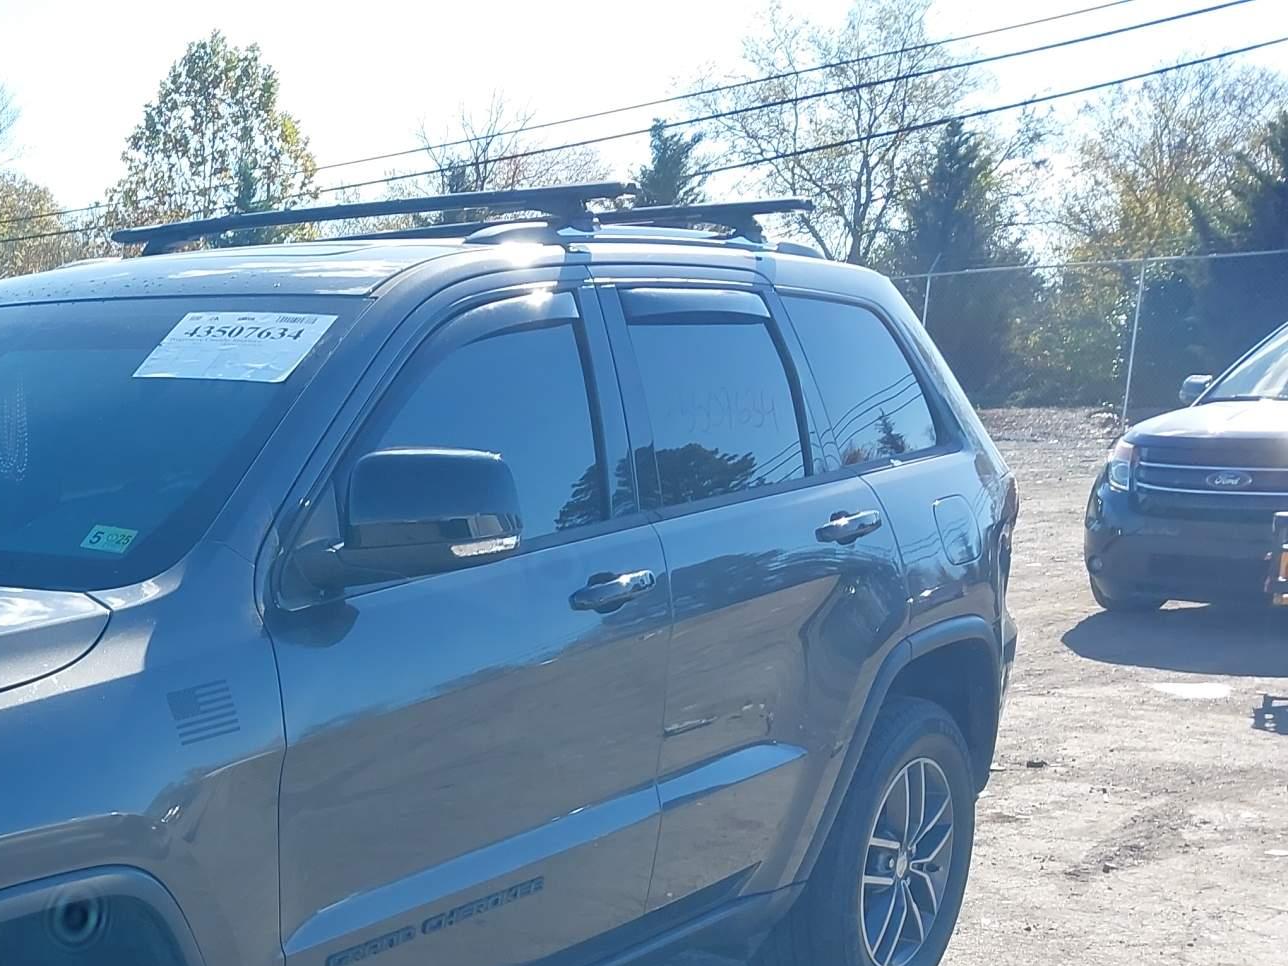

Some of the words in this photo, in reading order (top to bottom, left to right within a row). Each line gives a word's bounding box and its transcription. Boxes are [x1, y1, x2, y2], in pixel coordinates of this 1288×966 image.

[184, 325, 305, 341] 43507634
[88, 531, 105, 545] 5
[115, 533, 133, 546] 25
[421, 874, 545, 935] CHEROKEE
